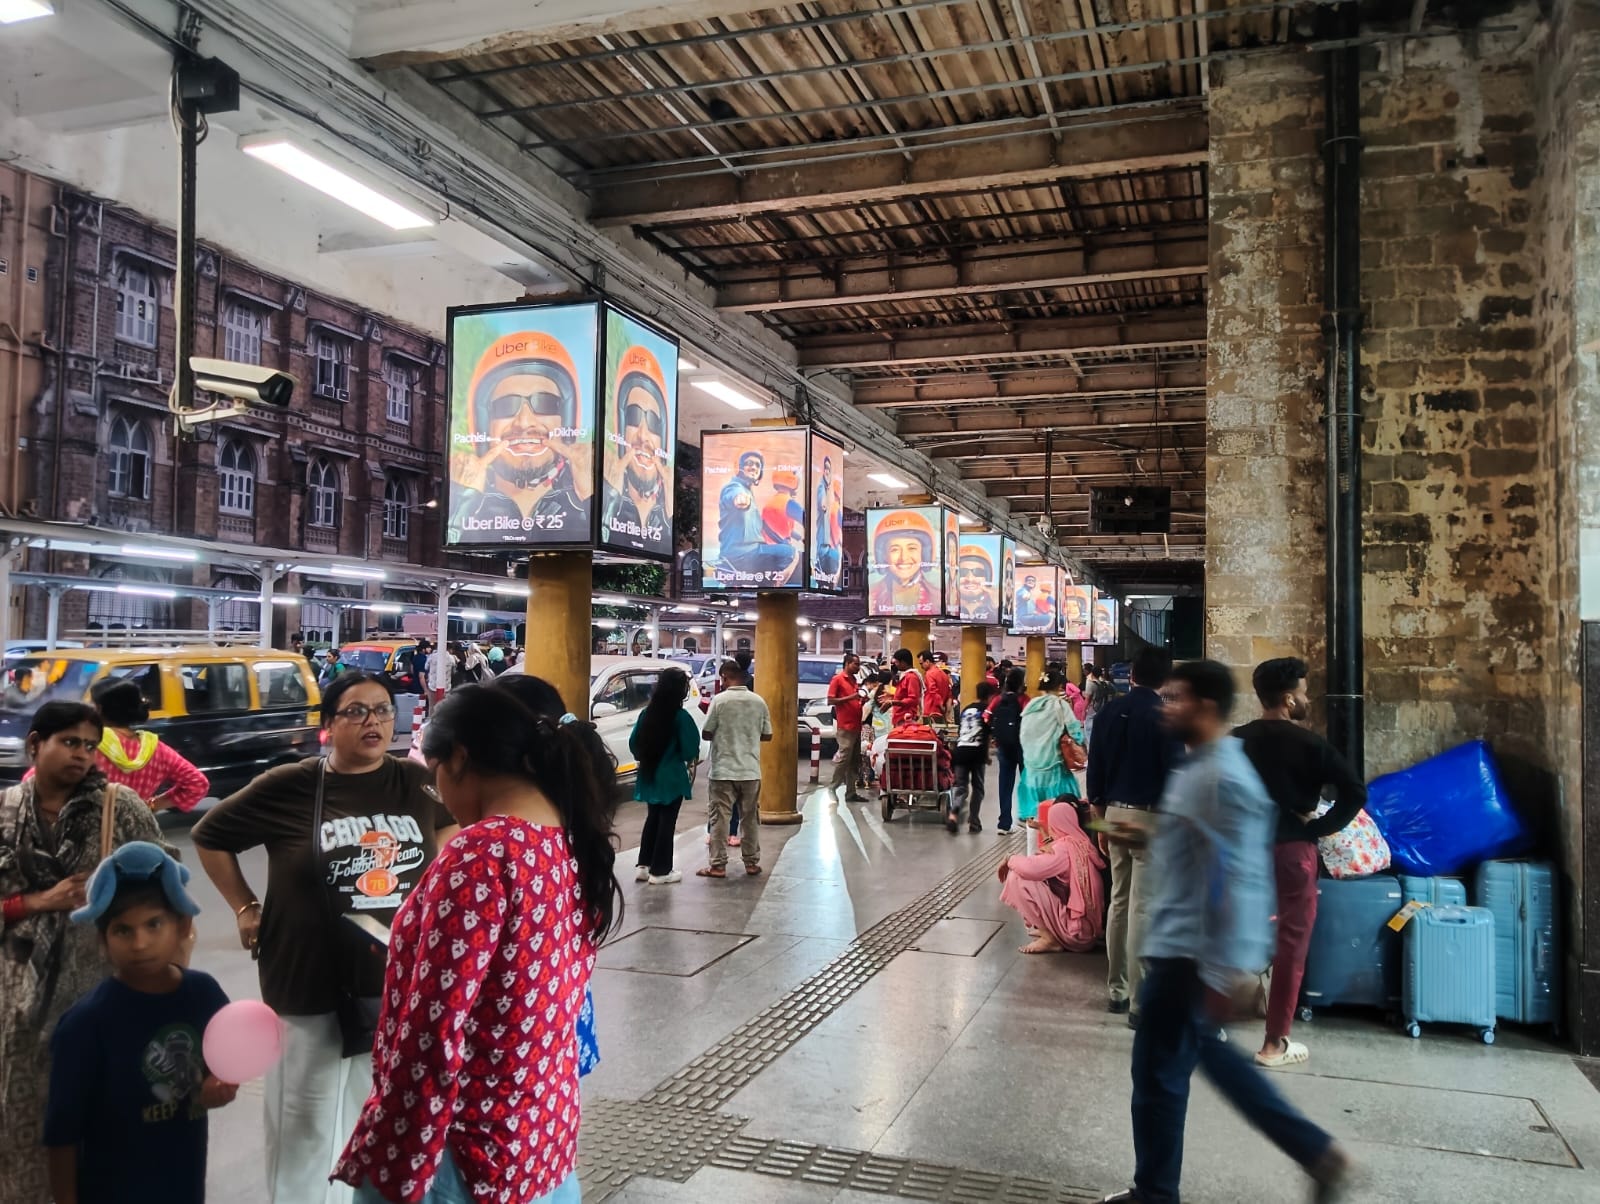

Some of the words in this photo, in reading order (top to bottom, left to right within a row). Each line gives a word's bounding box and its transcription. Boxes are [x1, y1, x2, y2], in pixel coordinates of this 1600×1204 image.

[494, 341, 527, 358] Uber
[454, 431, 487, 443] Pachisi
[462, 515, 493, 531] Uber
[494, 515, 520, 530] Bike
[521, 520, 534, 532] @
[609, 516, 627, 534] Uber
[713, 571, 735, 581] Uber
[320, 813, 424, 853] CHICAGO
